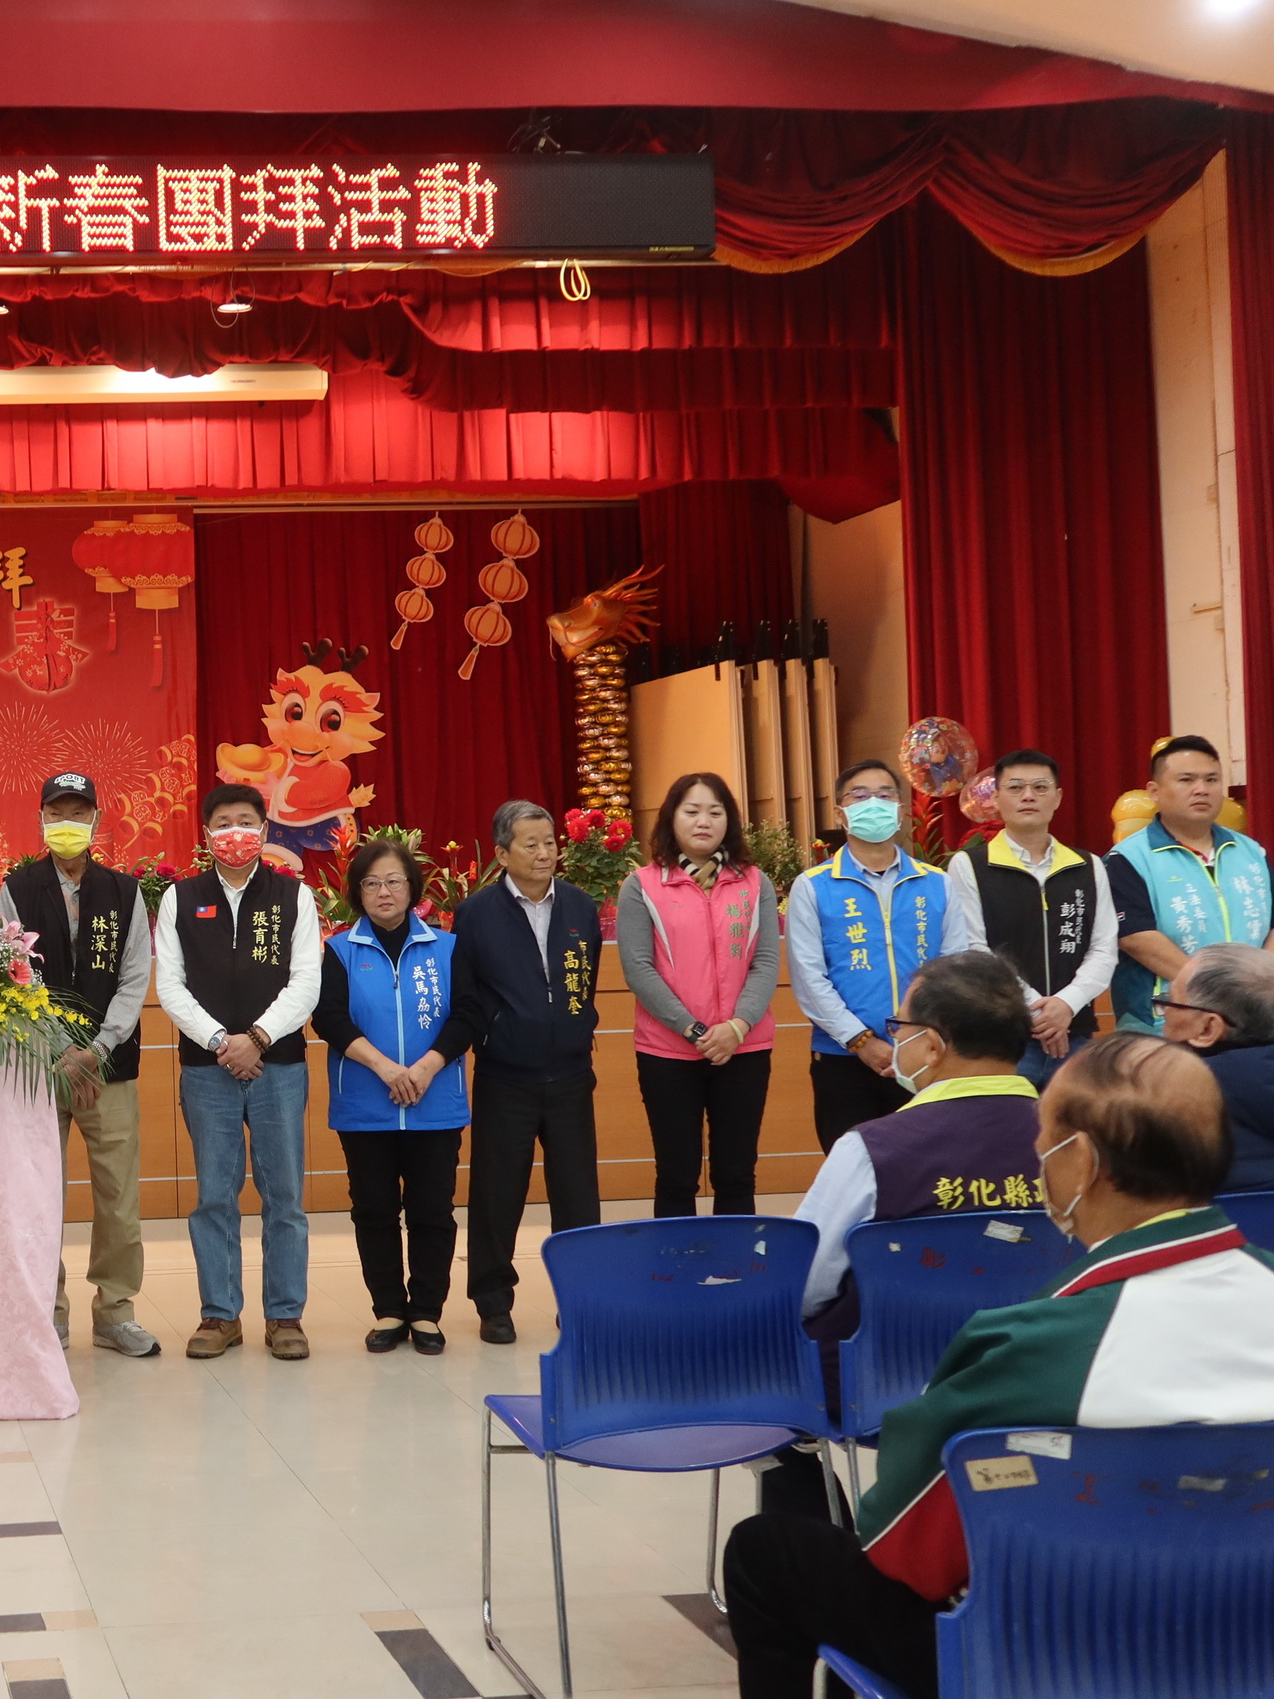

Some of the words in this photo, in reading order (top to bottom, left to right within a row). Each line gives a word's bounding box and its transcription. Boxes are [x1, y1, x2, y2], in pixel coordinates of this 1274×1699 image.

[91, 915, 110, 971] 林深山
[109, 909, 120, 974] 彰化市民代表
[252, 910, 270, 965] 張育彬
[271, 904, 282, 967] 彰化市民代表
[843, 897, 873, 972] 王世烈
[914, 896, 929, 969] 彰化市民代
[1058, 902, 1076, 955] 彭成翔
[425, 957, 443, 1019] 彰化市民代表
[564, 949, 583, 1016] 高龍奎
[578, 940, 593, 1002] 市民代表
